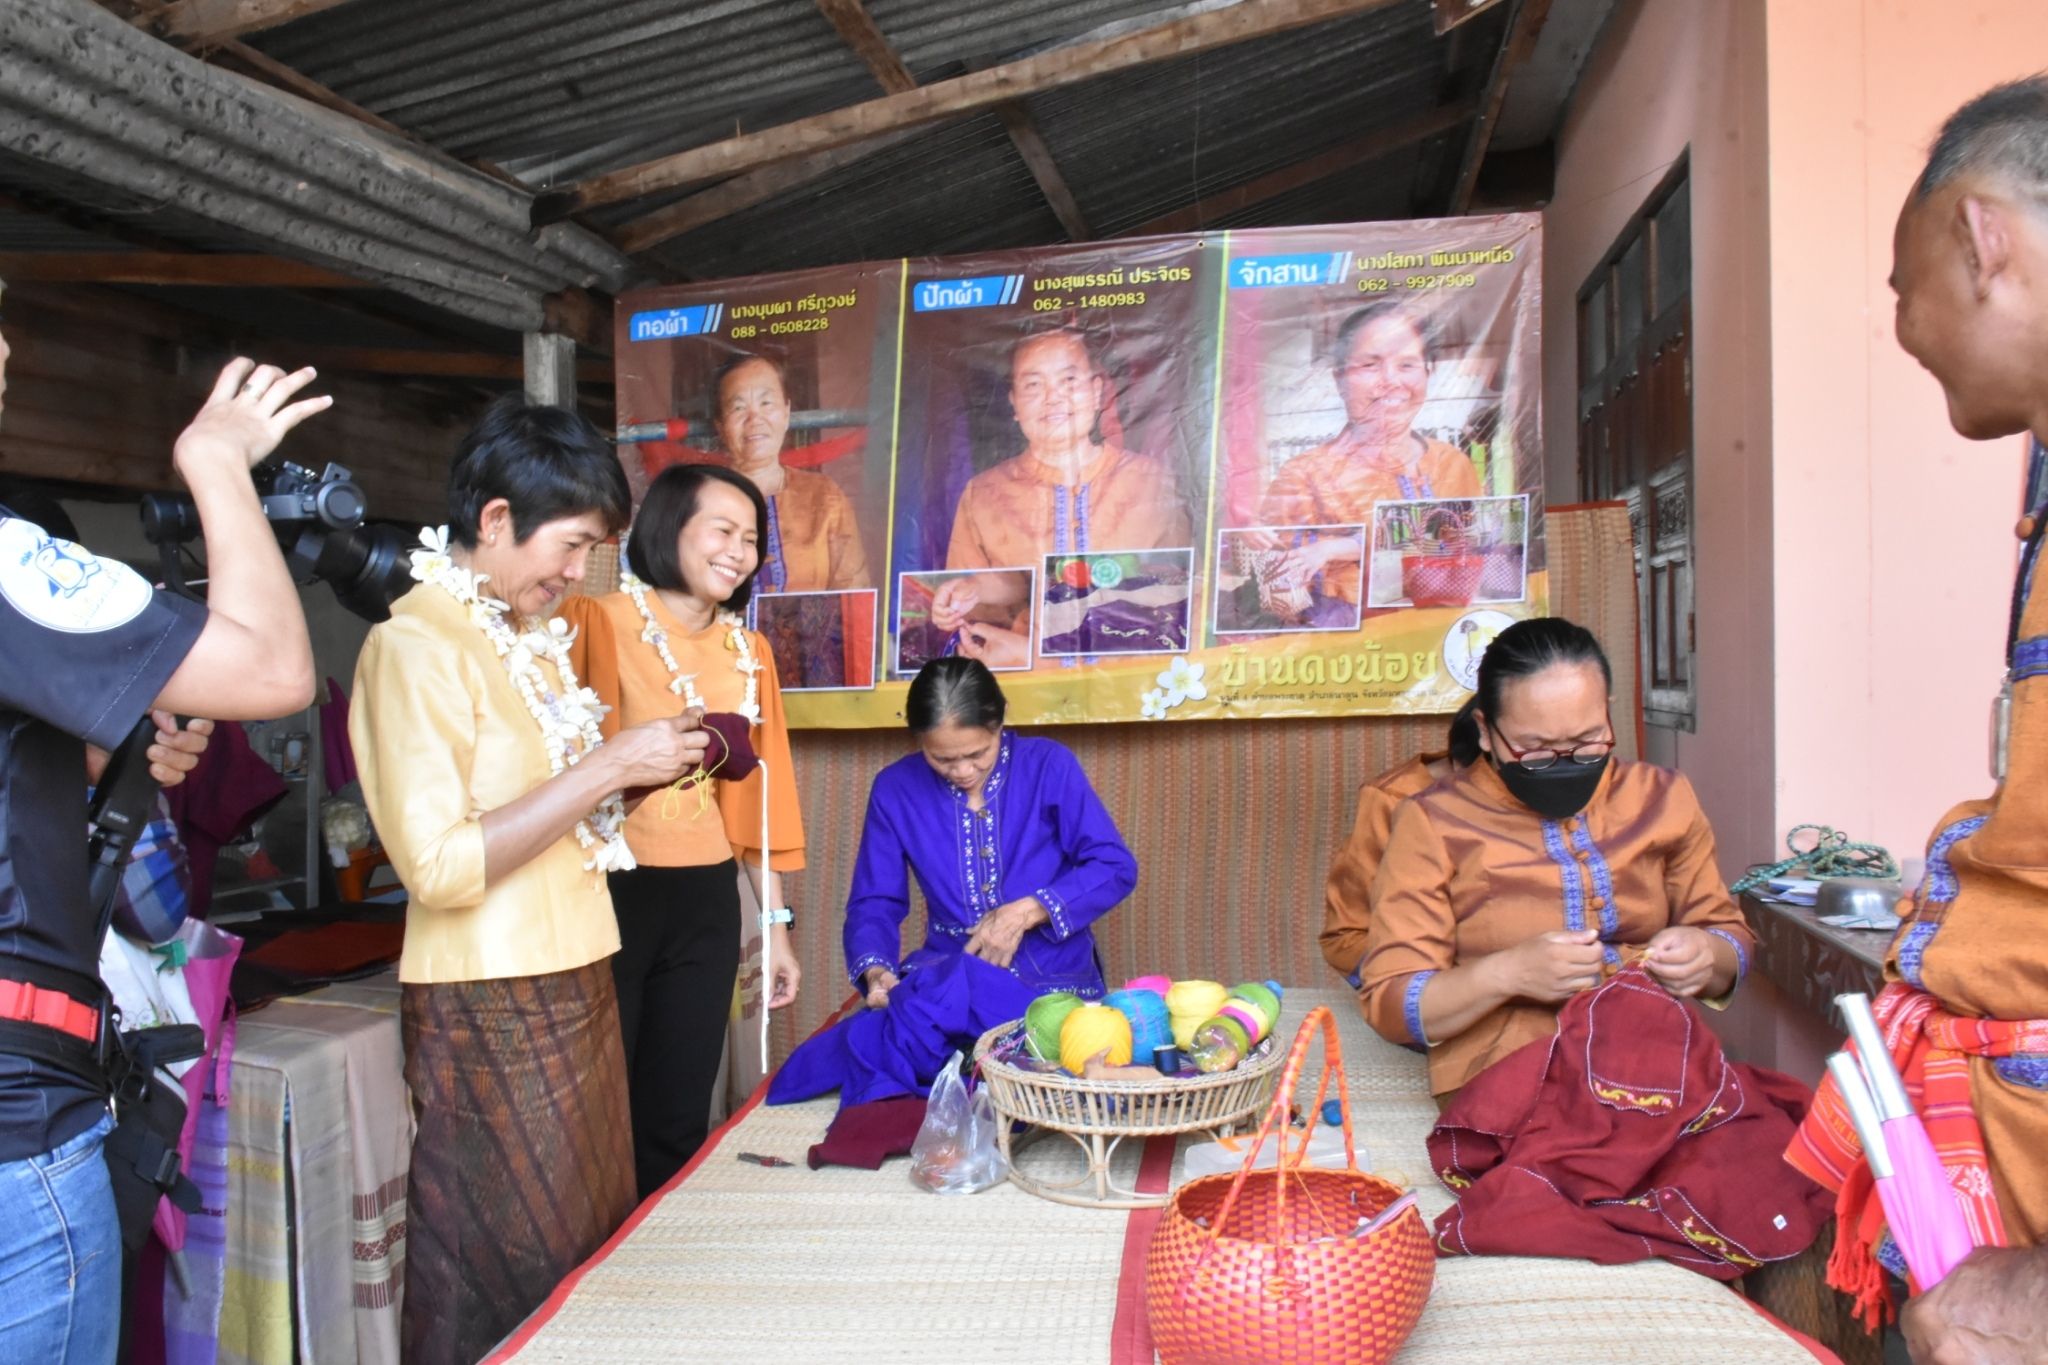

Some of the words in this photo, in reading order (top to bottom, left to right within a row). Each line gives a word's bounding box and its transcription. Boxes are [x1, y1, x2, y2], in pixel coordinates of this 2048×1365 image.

[1033, 267, 1123, 293] นางสุพรรณี
[1129, 265, 1192, 284] ประจิตร
[1238, 260, 1317, 286] จักสาน
[1358, 278, 1388, 292] 062
[1406, 274, 1476, 289] 9927909
[923, 280, 983, 308] ปักผ้า
[1033, 298, 1062, 311] 062
[1079, 292, 1145, 308] 1480983
[638, 309, 688, 338] ทอผ้า
[731, 325, 756, 338] 088
[770, 317, 829, 335] 0508228
[1221, 640, 1437, 688] บ้านดงน้อย
